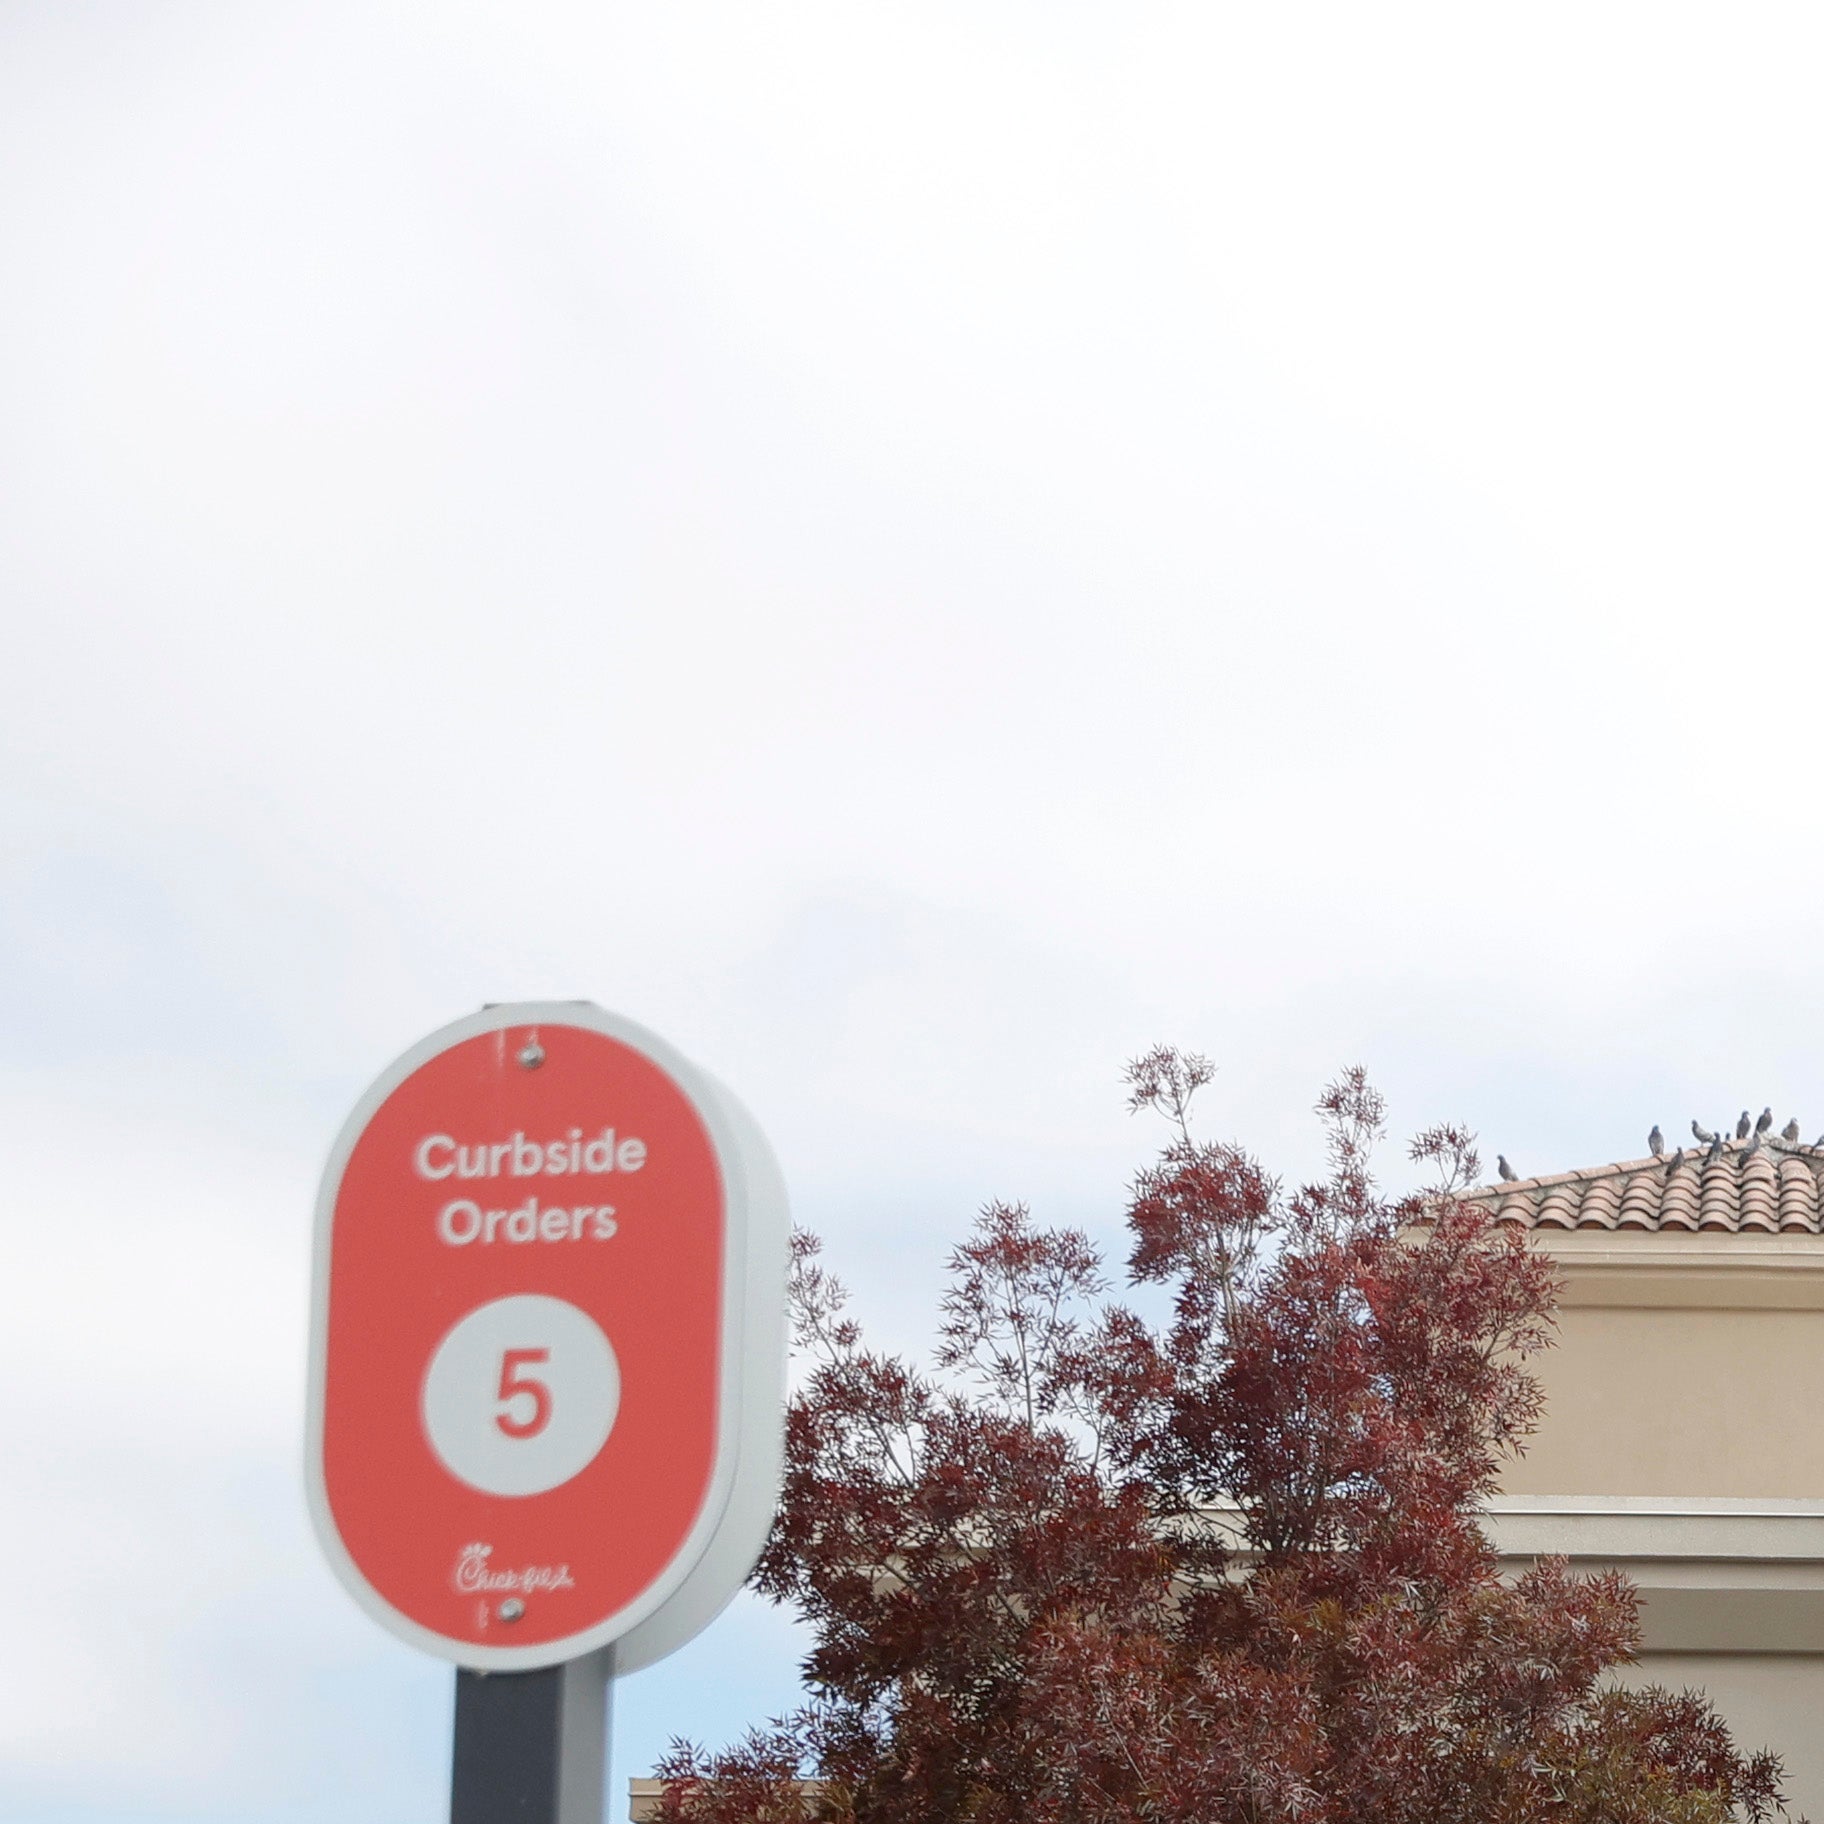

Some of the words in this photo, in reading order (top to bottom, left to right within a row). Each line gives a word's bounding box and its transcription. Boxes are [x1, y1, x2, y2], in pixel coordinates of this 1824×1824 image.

[414, 1127, 648, 1181] Curbside
[438, 1199, 618, 1246] Orders
[495, 1346, 553, 1440] 5
